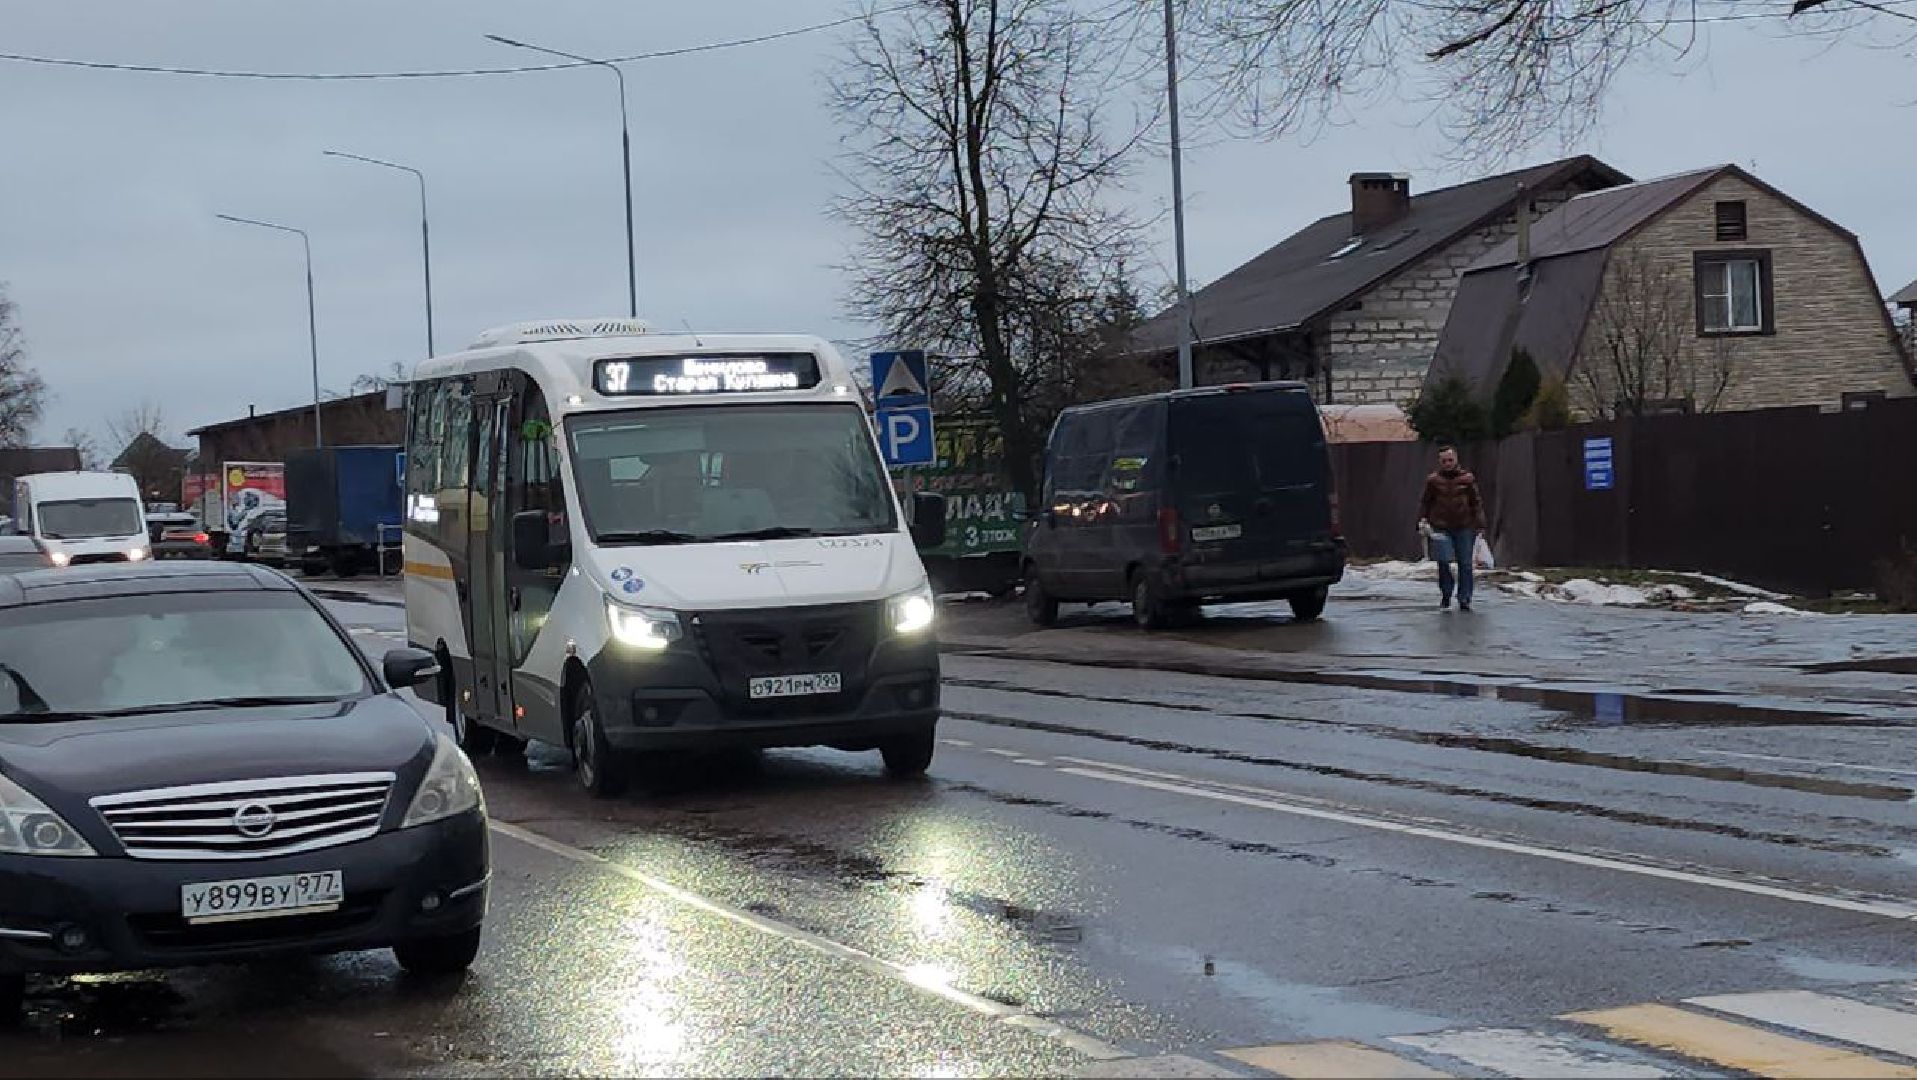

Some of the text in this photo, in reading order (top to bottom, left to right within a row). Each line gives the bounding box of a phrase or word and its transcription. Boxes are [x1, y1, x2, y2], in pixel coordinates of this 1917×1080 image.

[606, 363, 630, 392] 37
[653, 374, 718, 392] Старая
[888, 415, 920, 459] P
